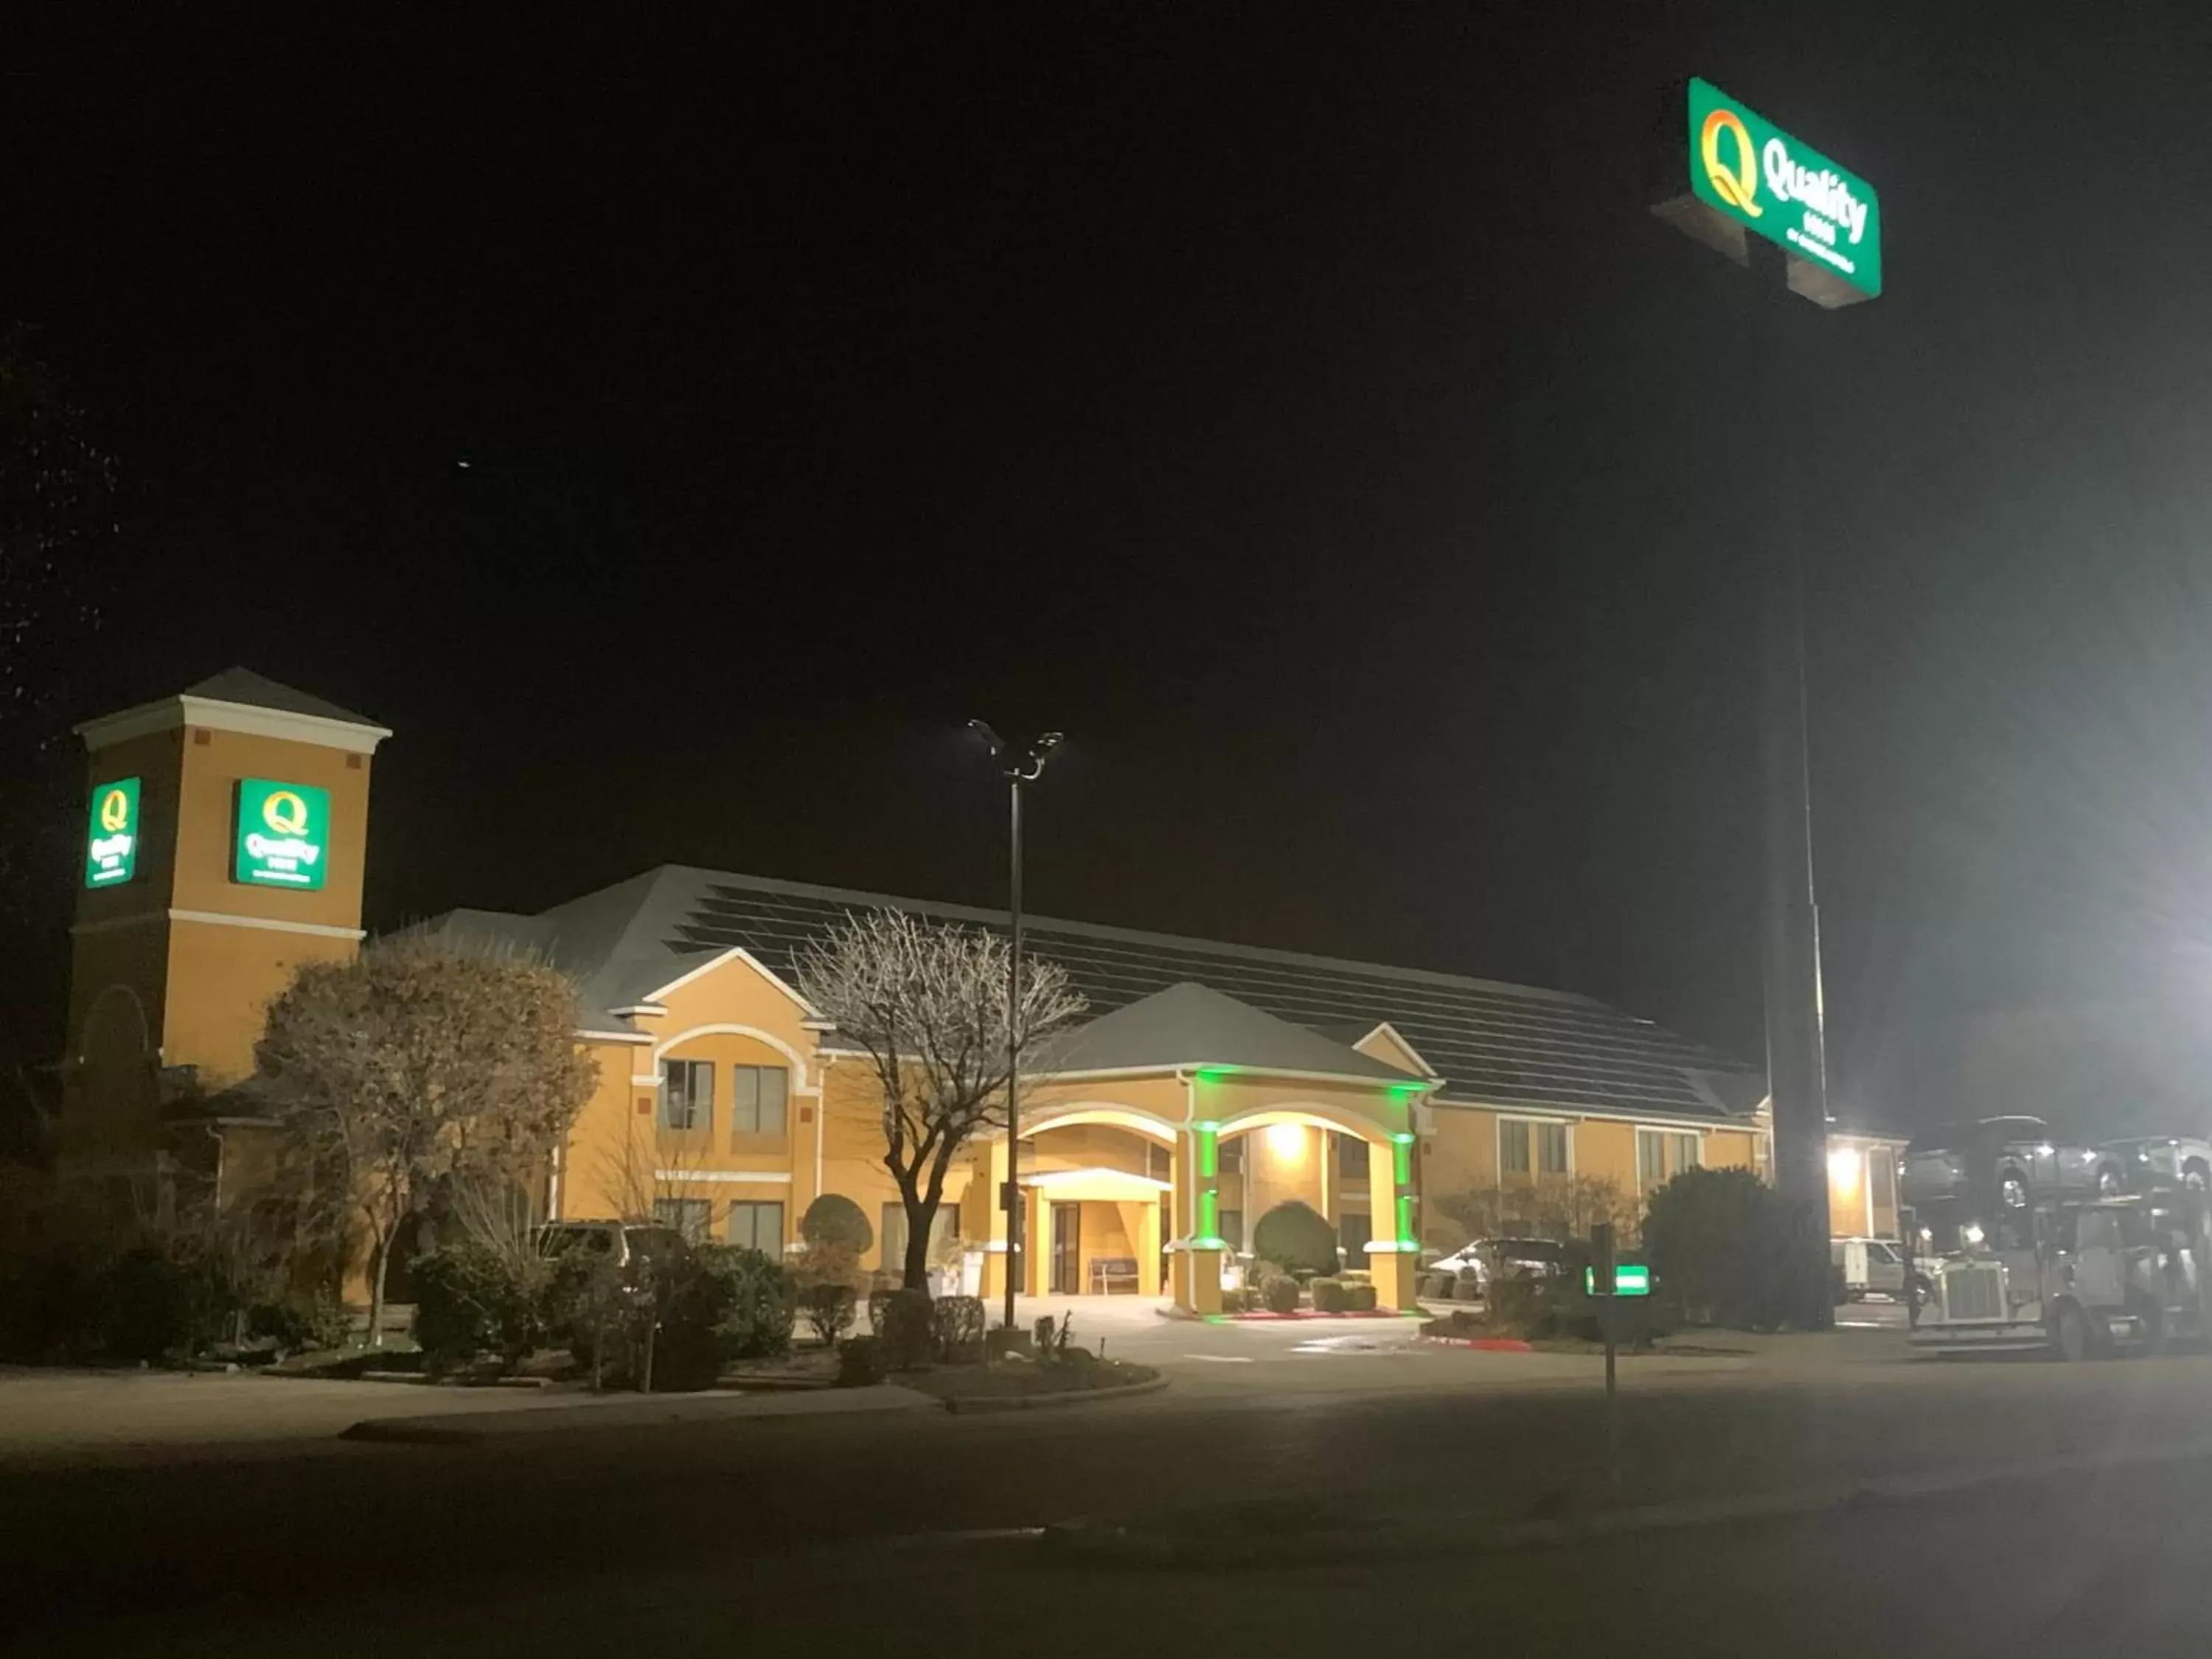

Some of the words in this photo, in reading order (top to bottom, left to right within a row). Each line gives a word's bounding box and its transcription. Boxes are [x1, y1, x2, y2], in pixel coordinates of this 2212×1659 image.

[1701, 108, 1763, 218] Q
[1763, 137, 1868, 245] Quality
[102, 789, 127, 832] Q
[262, 790, 309, 835] Q
